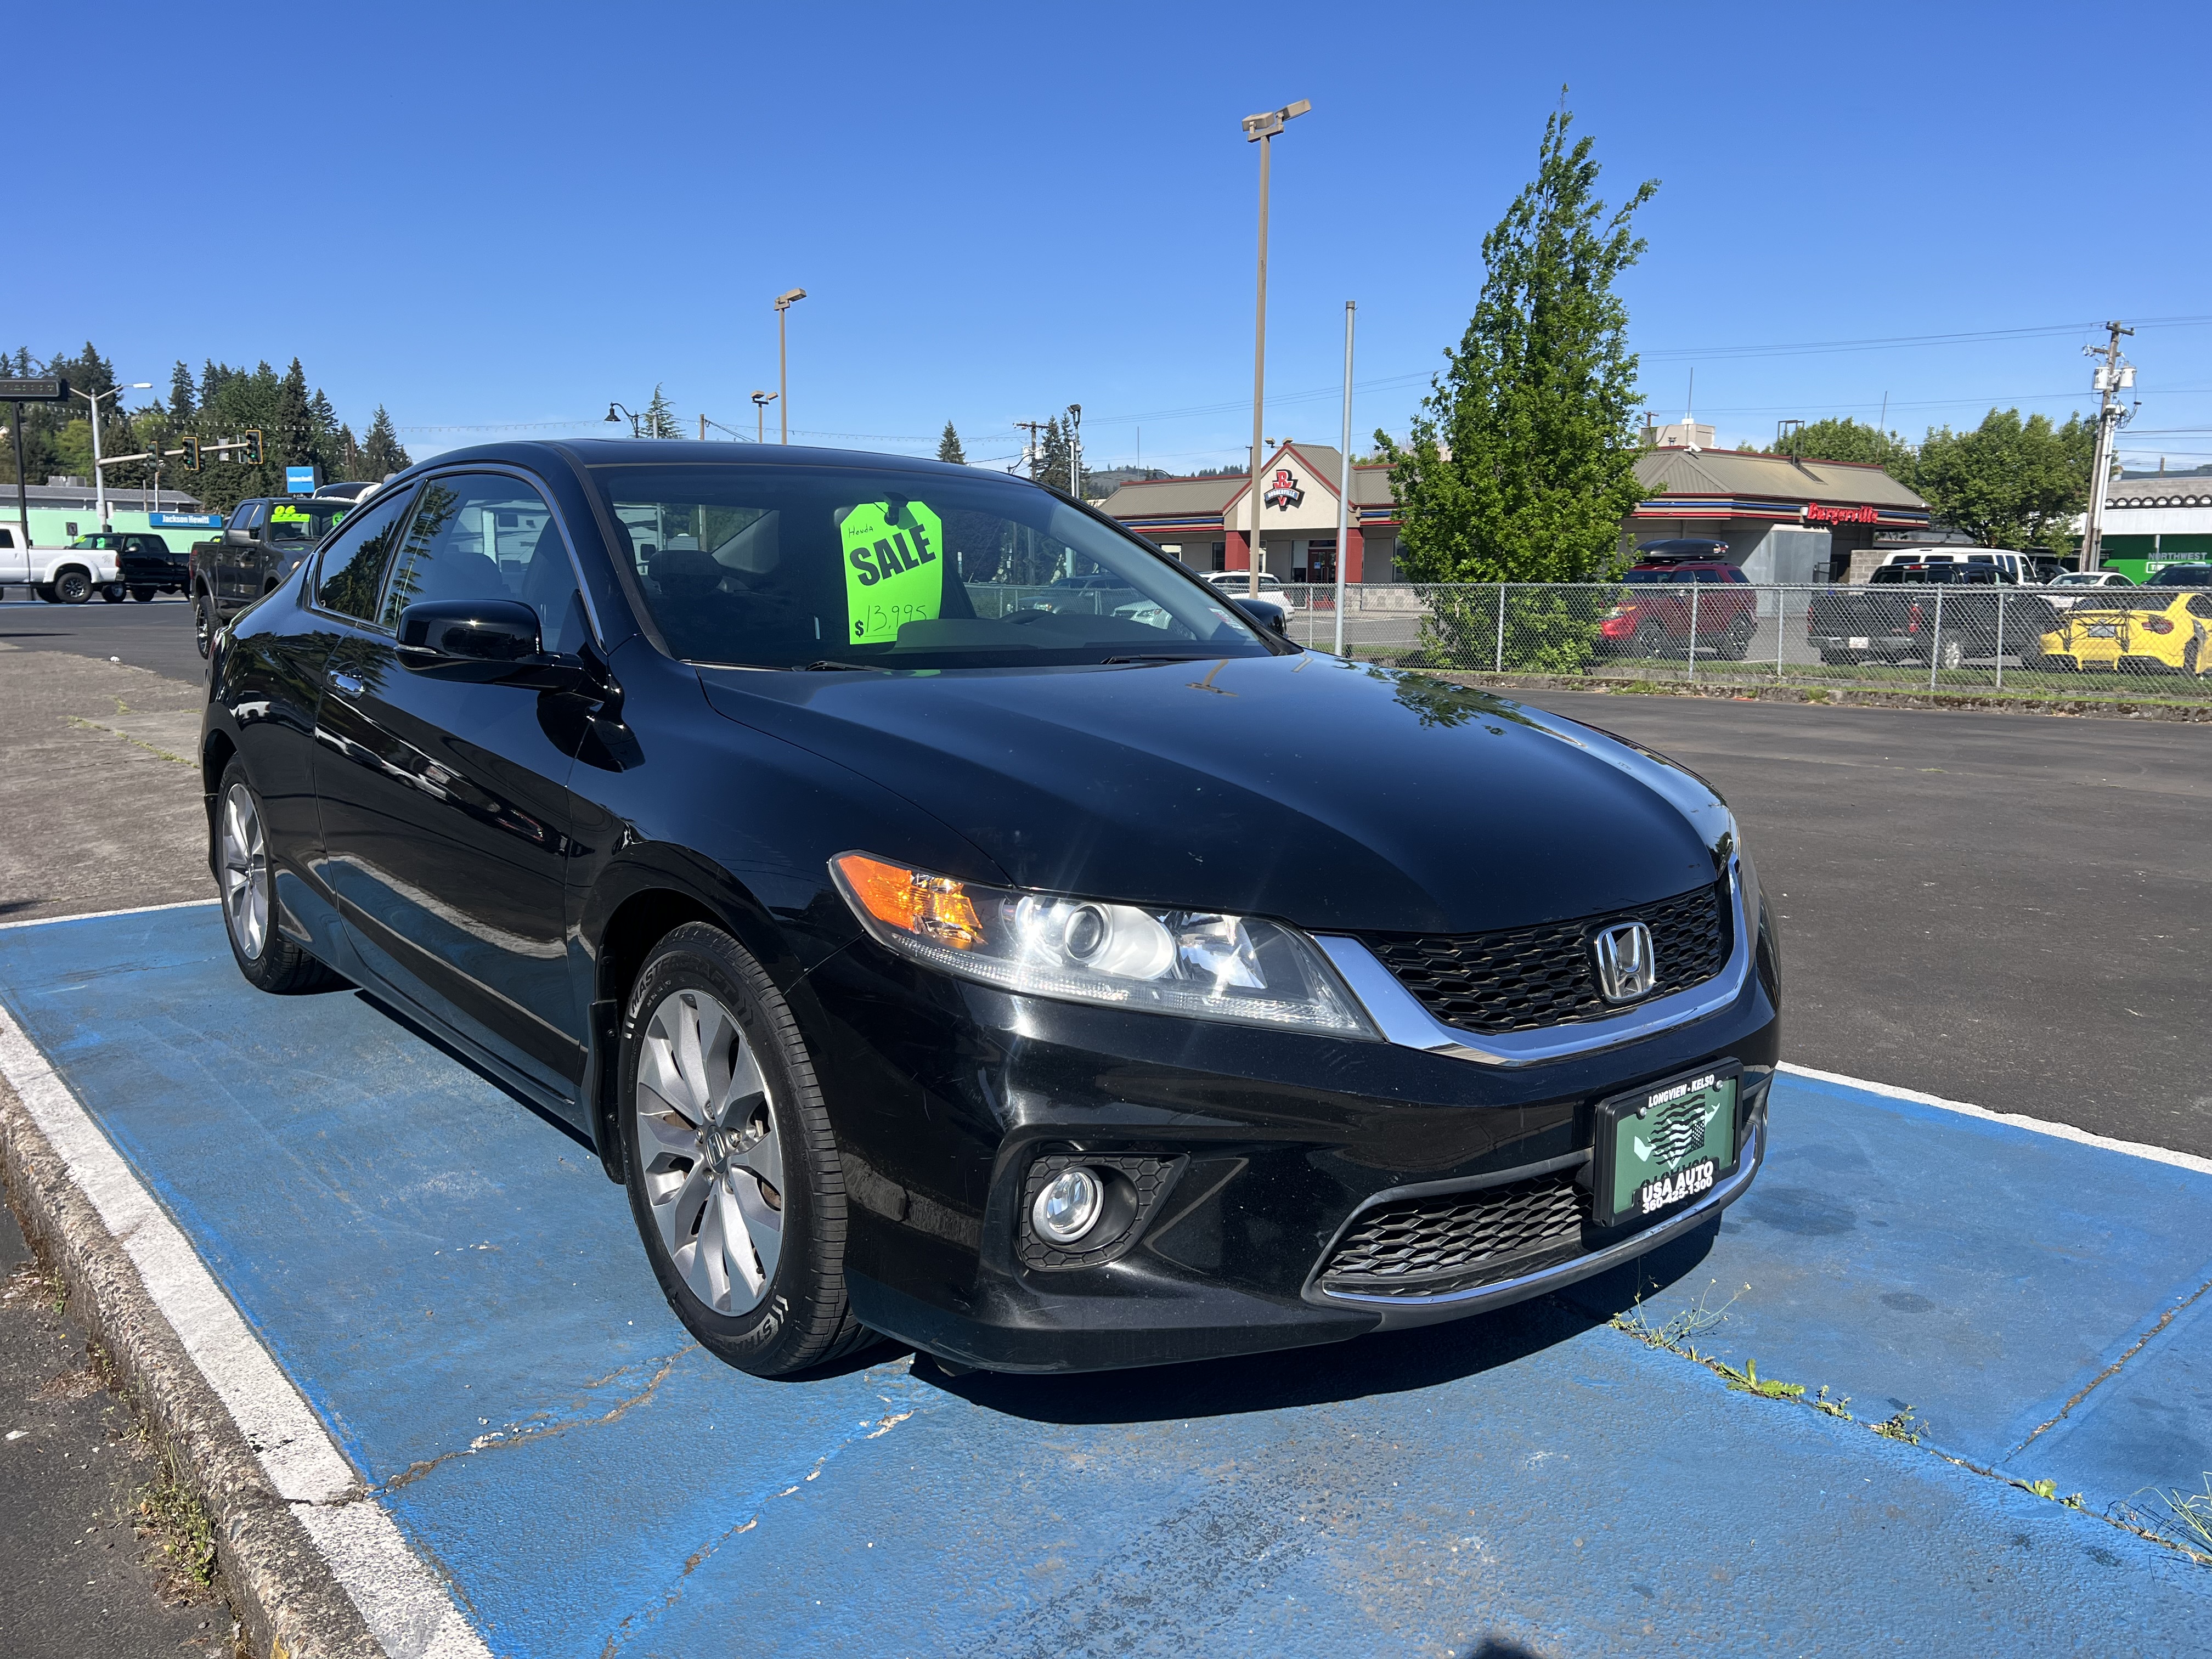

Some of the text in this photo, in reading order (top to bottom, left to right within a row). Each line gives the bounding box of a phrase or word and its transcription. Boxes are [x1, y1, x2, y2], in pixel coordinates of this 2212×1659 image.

[162, 515, 210, 524] Jackson Hewitt
[1807, 503, 1878, 525] Burgerville
[850, 523, 936, 586] SALE
[1648, 1084, 1688, 1108] LONGVIEW
[1691, 1074, 1714, 1092] KELSO
[1642, 1176, 1713, 1214] 360-425-1300
[1643, 1177, 1673, 1203] USA
[1675, 1161, 1713, 1190] AUTO
